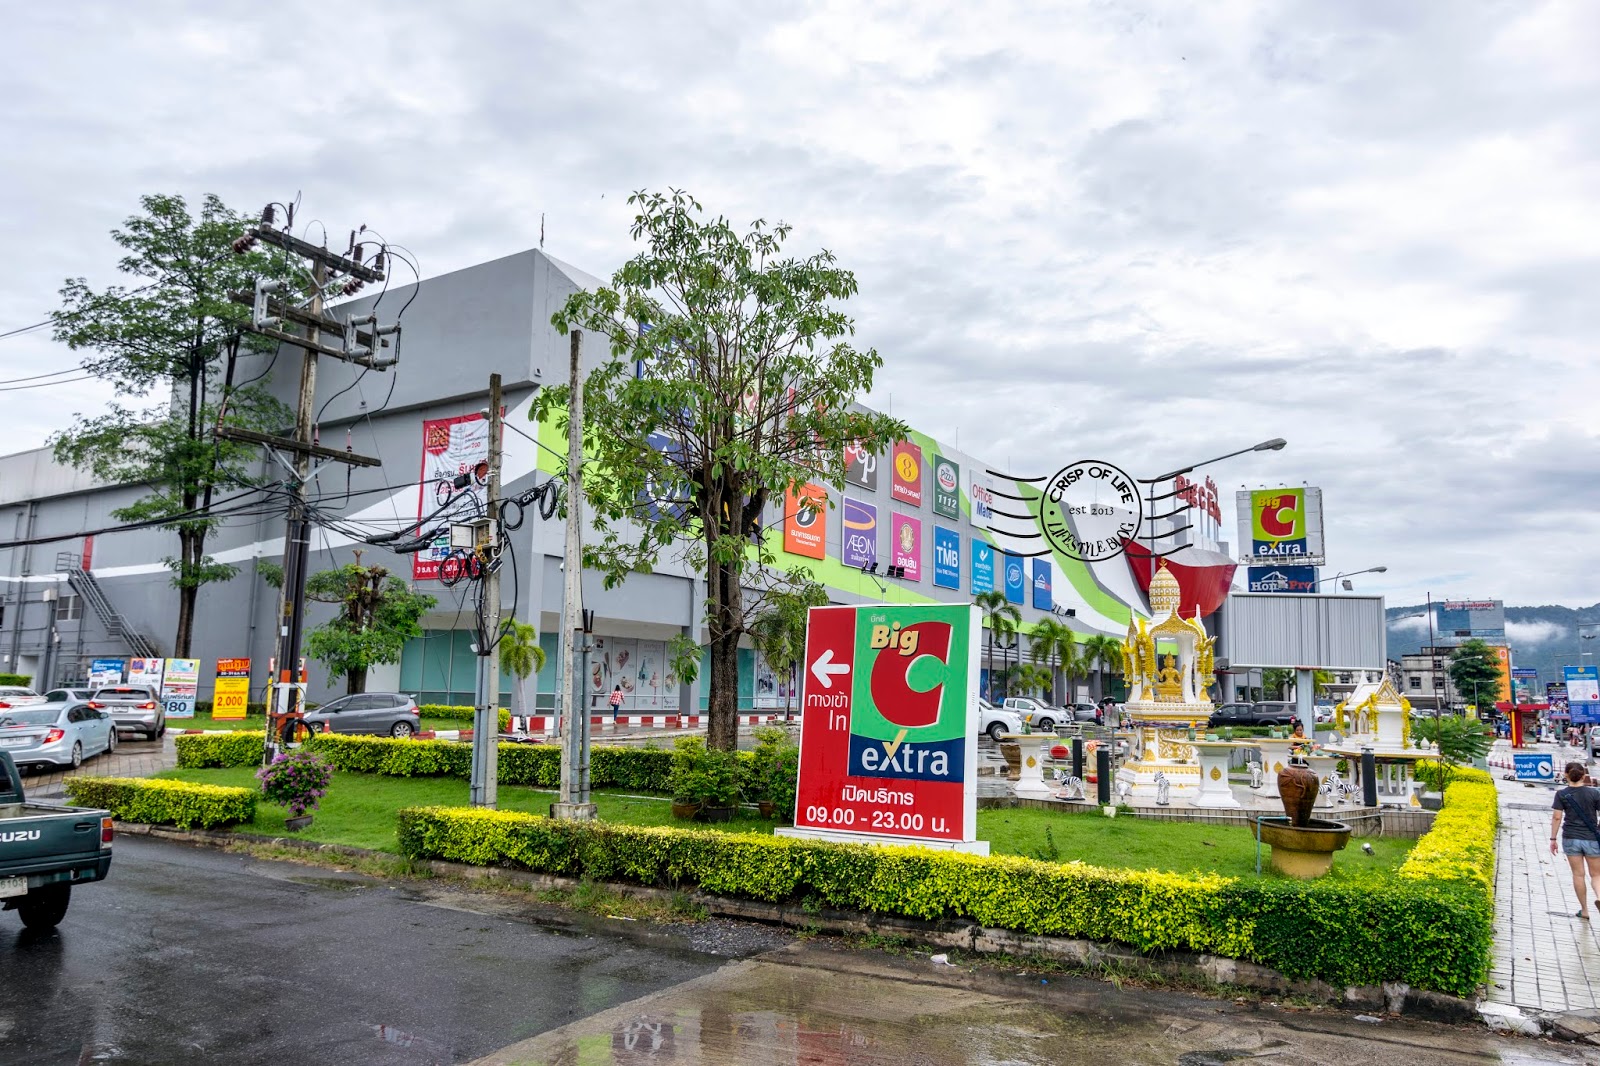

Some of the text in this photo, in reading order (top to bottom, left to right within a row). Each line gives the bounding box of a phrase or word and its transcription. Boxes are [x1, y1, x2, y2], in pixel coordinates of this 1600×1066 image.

[522, 492, 535, 503] CAT
[938, 494, 957, 509] 1112
[972, 484, 992, 505] Office
[1257, 496, 1281, 509] Big
[1260, 494, 1298, 538] C
[936, 545, 959, 568] TMB
[870, 621, 920, 657] Big
[870, 621, 953, 728] C
[162, 701, 187, 712] 180
[217, 696, 243, 707] 2,000
[807, 691, 848, 709] ทางเข้า
[829, 710, 847, 731] In
[842, 784, 915, 806] เปิดบริการ
[806, 805, 855, 826] 09.00
[872, 810, 924, 831] 23.00
[931, 816, 950, 834] น.
